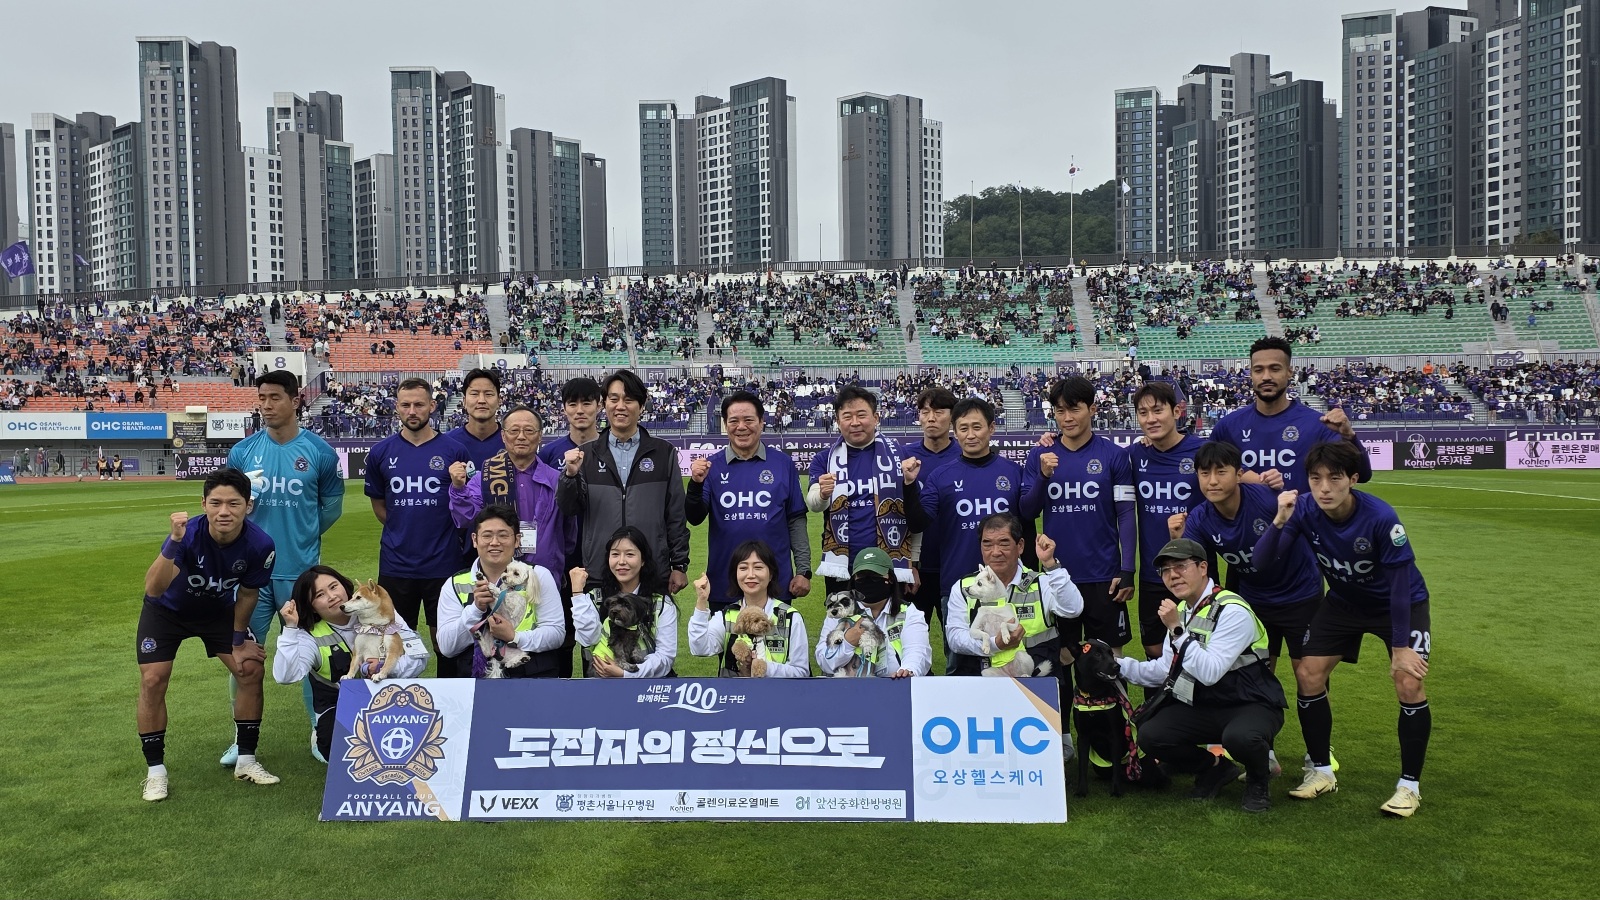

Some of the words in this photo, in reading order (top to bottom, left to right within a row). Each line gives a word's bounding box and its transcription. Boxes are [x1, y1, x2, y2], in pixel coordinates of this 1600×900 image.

[274, 356, 287, 369] 8
[1202, 363, 1219, 372] R21
[1496, 358, 1514, 367] R23
[515, 373, 532, 381] R16
[648, 372, 665, 380] R17
[784, 370, 800, 379] R18
[7, 421, 38, 431] OHC
[91, 421, 121, 431] OHC
[1436, 445, 1495, 455] 콜렌온열매트
[1241, 448, 1297, 468] OHC
[1404, 459, 1436, 467] Kohlen
[1436, 455, 1473, 465] (주)자운
[1518, 458, 1550, 466] Kohlen
[1551, 455, 1588, 464] (주)자운
[876, 454, 897, 490] FC
[390, 476, 441, 494] OHC
[1047, 480, 1100, 500] OHC
[1138, 480, 1192, 501] OHC
[394, 499, 438, 507] 오상헬스케어
[719, 490, 772, 509] OHC
[955, 497, 1010, 517] OHC
[1051, 503, 1097, 513] 오상헬스케어
[723, 512, 768, 521] 오상헬스케어
[1316, 552, 1375, 576] OHC
[187, 573, 240, 593] OHC
[1118, 610, 1126, 631] 4
[1410, 629, 1431, 654] 28
[646, 684, 672, 694] 시민과
[636, 694, 670, 703] 함께하는
[675, 682, 718, 710] 100
[719, 695, 728, 704] 년
[728, 695, 746, 704] 구단
[371, 714, 430, 724] ANYANG
[921, 716, 1051, 756] OHC
[493, 726, 686, 770] 도전자의
[690, 726, 886, 769] 정신으로
[932, 768, 1043, 787] 오상헬스케어
[335, 800, 441, 817] ANYANG
[501, 797, 539, 810] VEXX
[576, 799, 655, 811] 평촌서울나우병원
[696, 797, 780, 808] 콜렌의료온열매트
[815, 797, 903, 810] 앞선중화한방병원
